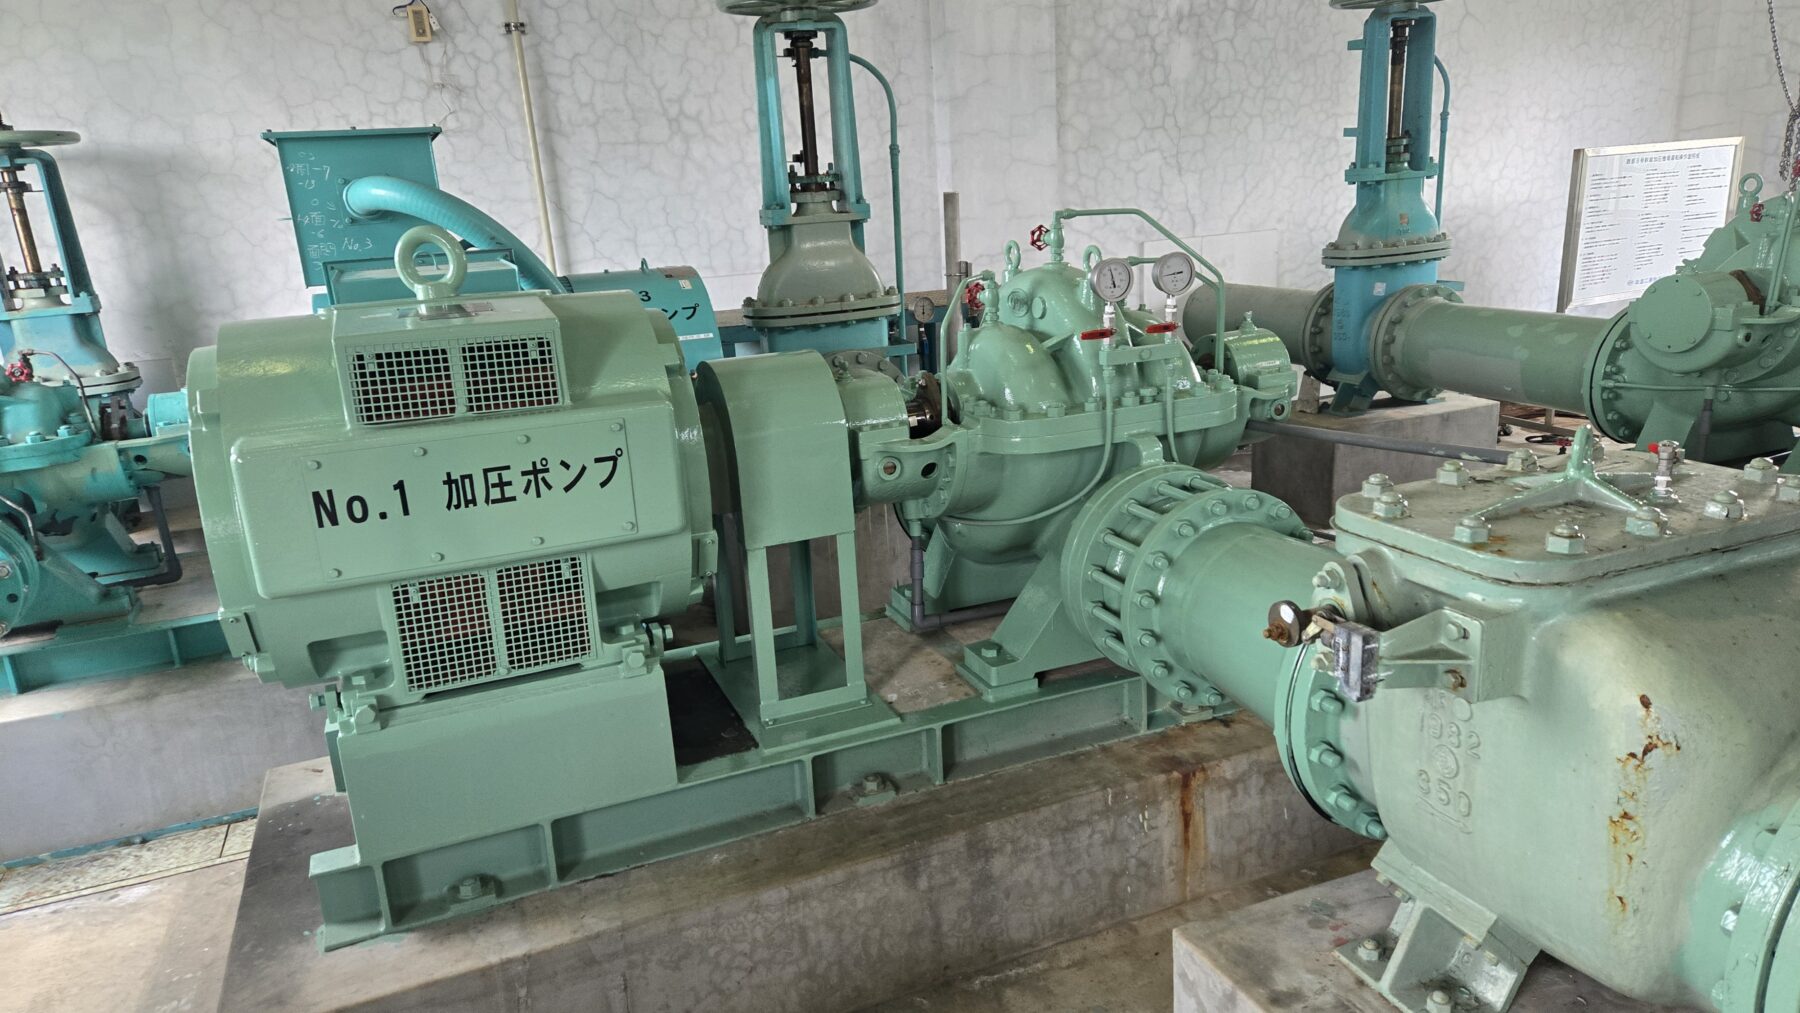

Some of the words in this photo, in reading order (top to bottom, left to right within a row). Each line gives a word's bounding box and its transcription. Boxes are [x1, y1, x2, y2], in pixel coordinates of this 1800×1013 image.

[311, 479, 410, 529] No.1
[442, 447, 624, 512] 加圧ポンプ
